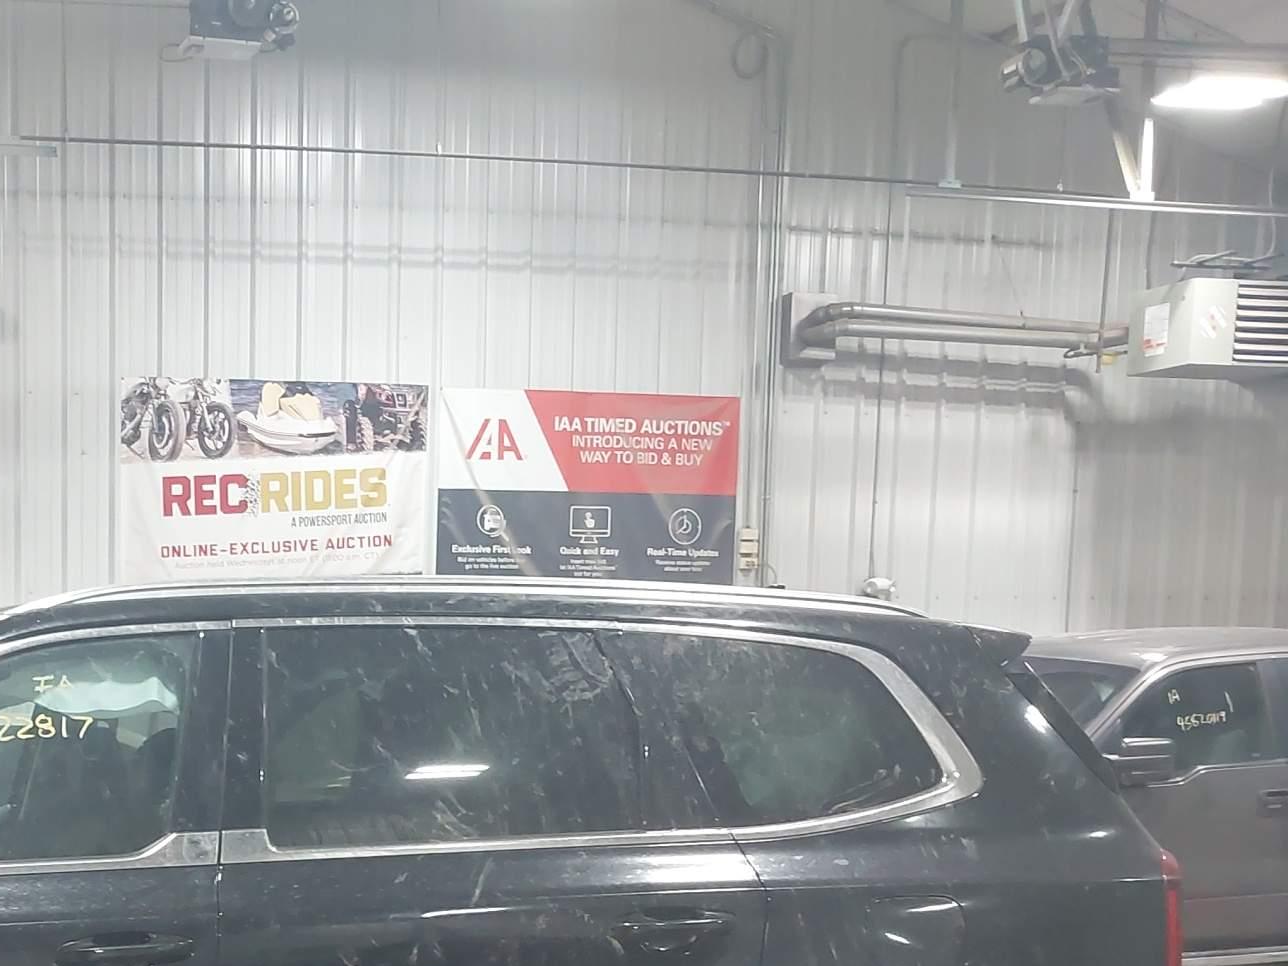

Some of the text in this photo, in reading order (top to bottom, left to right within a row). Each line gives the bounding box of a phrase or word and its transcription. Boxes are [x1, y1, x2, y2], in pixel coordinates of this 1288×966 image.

[554, 416, 582, 432] IAA
[584, 417, 637, 434] TIMED
[572, 434, 713, 451] INTRODUCING A NEW
[579, 451, 703, 466] WAY TO BID & BUY
[162, 467, 389, 517] REC RIDES
[291, 511, 388, 528] A POWERSPORT AUCTION
[161, 538, 319, 559] ONLINE-EXCLUSIVE
[325, 534, 393, 551] AUCTION
[451, 544, 492, 554] Exclusive
[559, 546, 620, 557] Quick and Easy
[646, 547, 720, 558] Real-Time Updates
